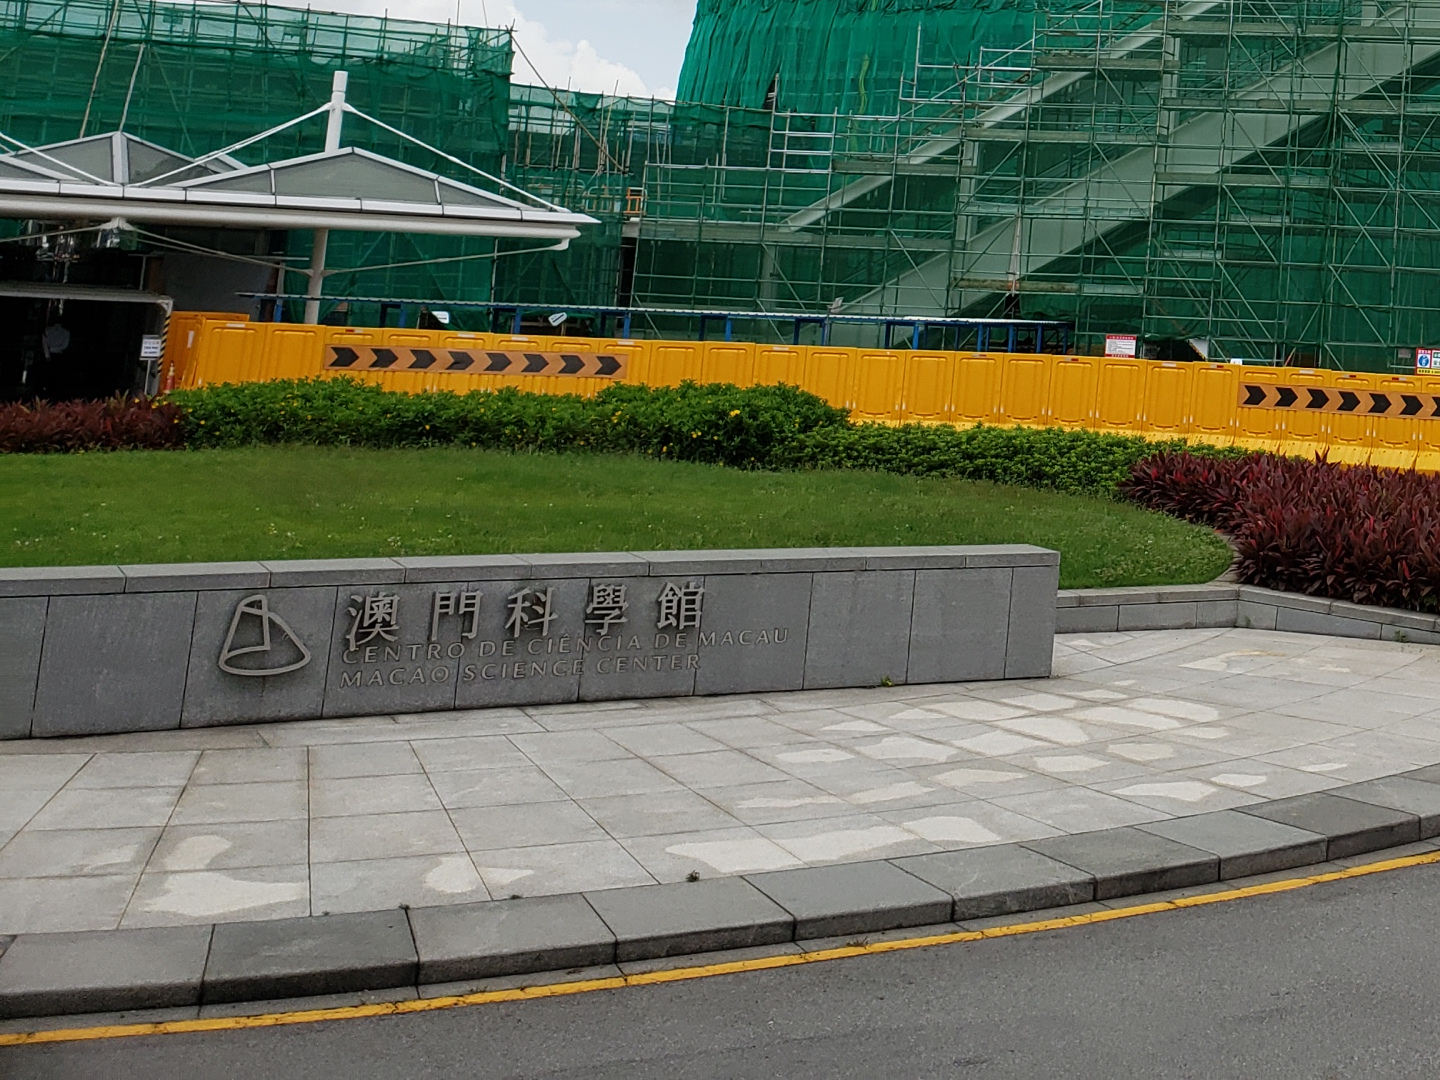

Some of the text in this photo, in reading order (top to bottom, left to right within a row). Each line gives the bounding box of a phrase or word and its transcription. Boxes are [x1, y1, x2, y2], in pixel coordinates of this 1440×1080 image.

[345, 581, 706, 651] 澳門科學館
[342, 628, 789, 664] CENTRO DE CIÊNCIA DE MACAU
[340, 654, 701, 688] MACAO SCIENCE CENTER
